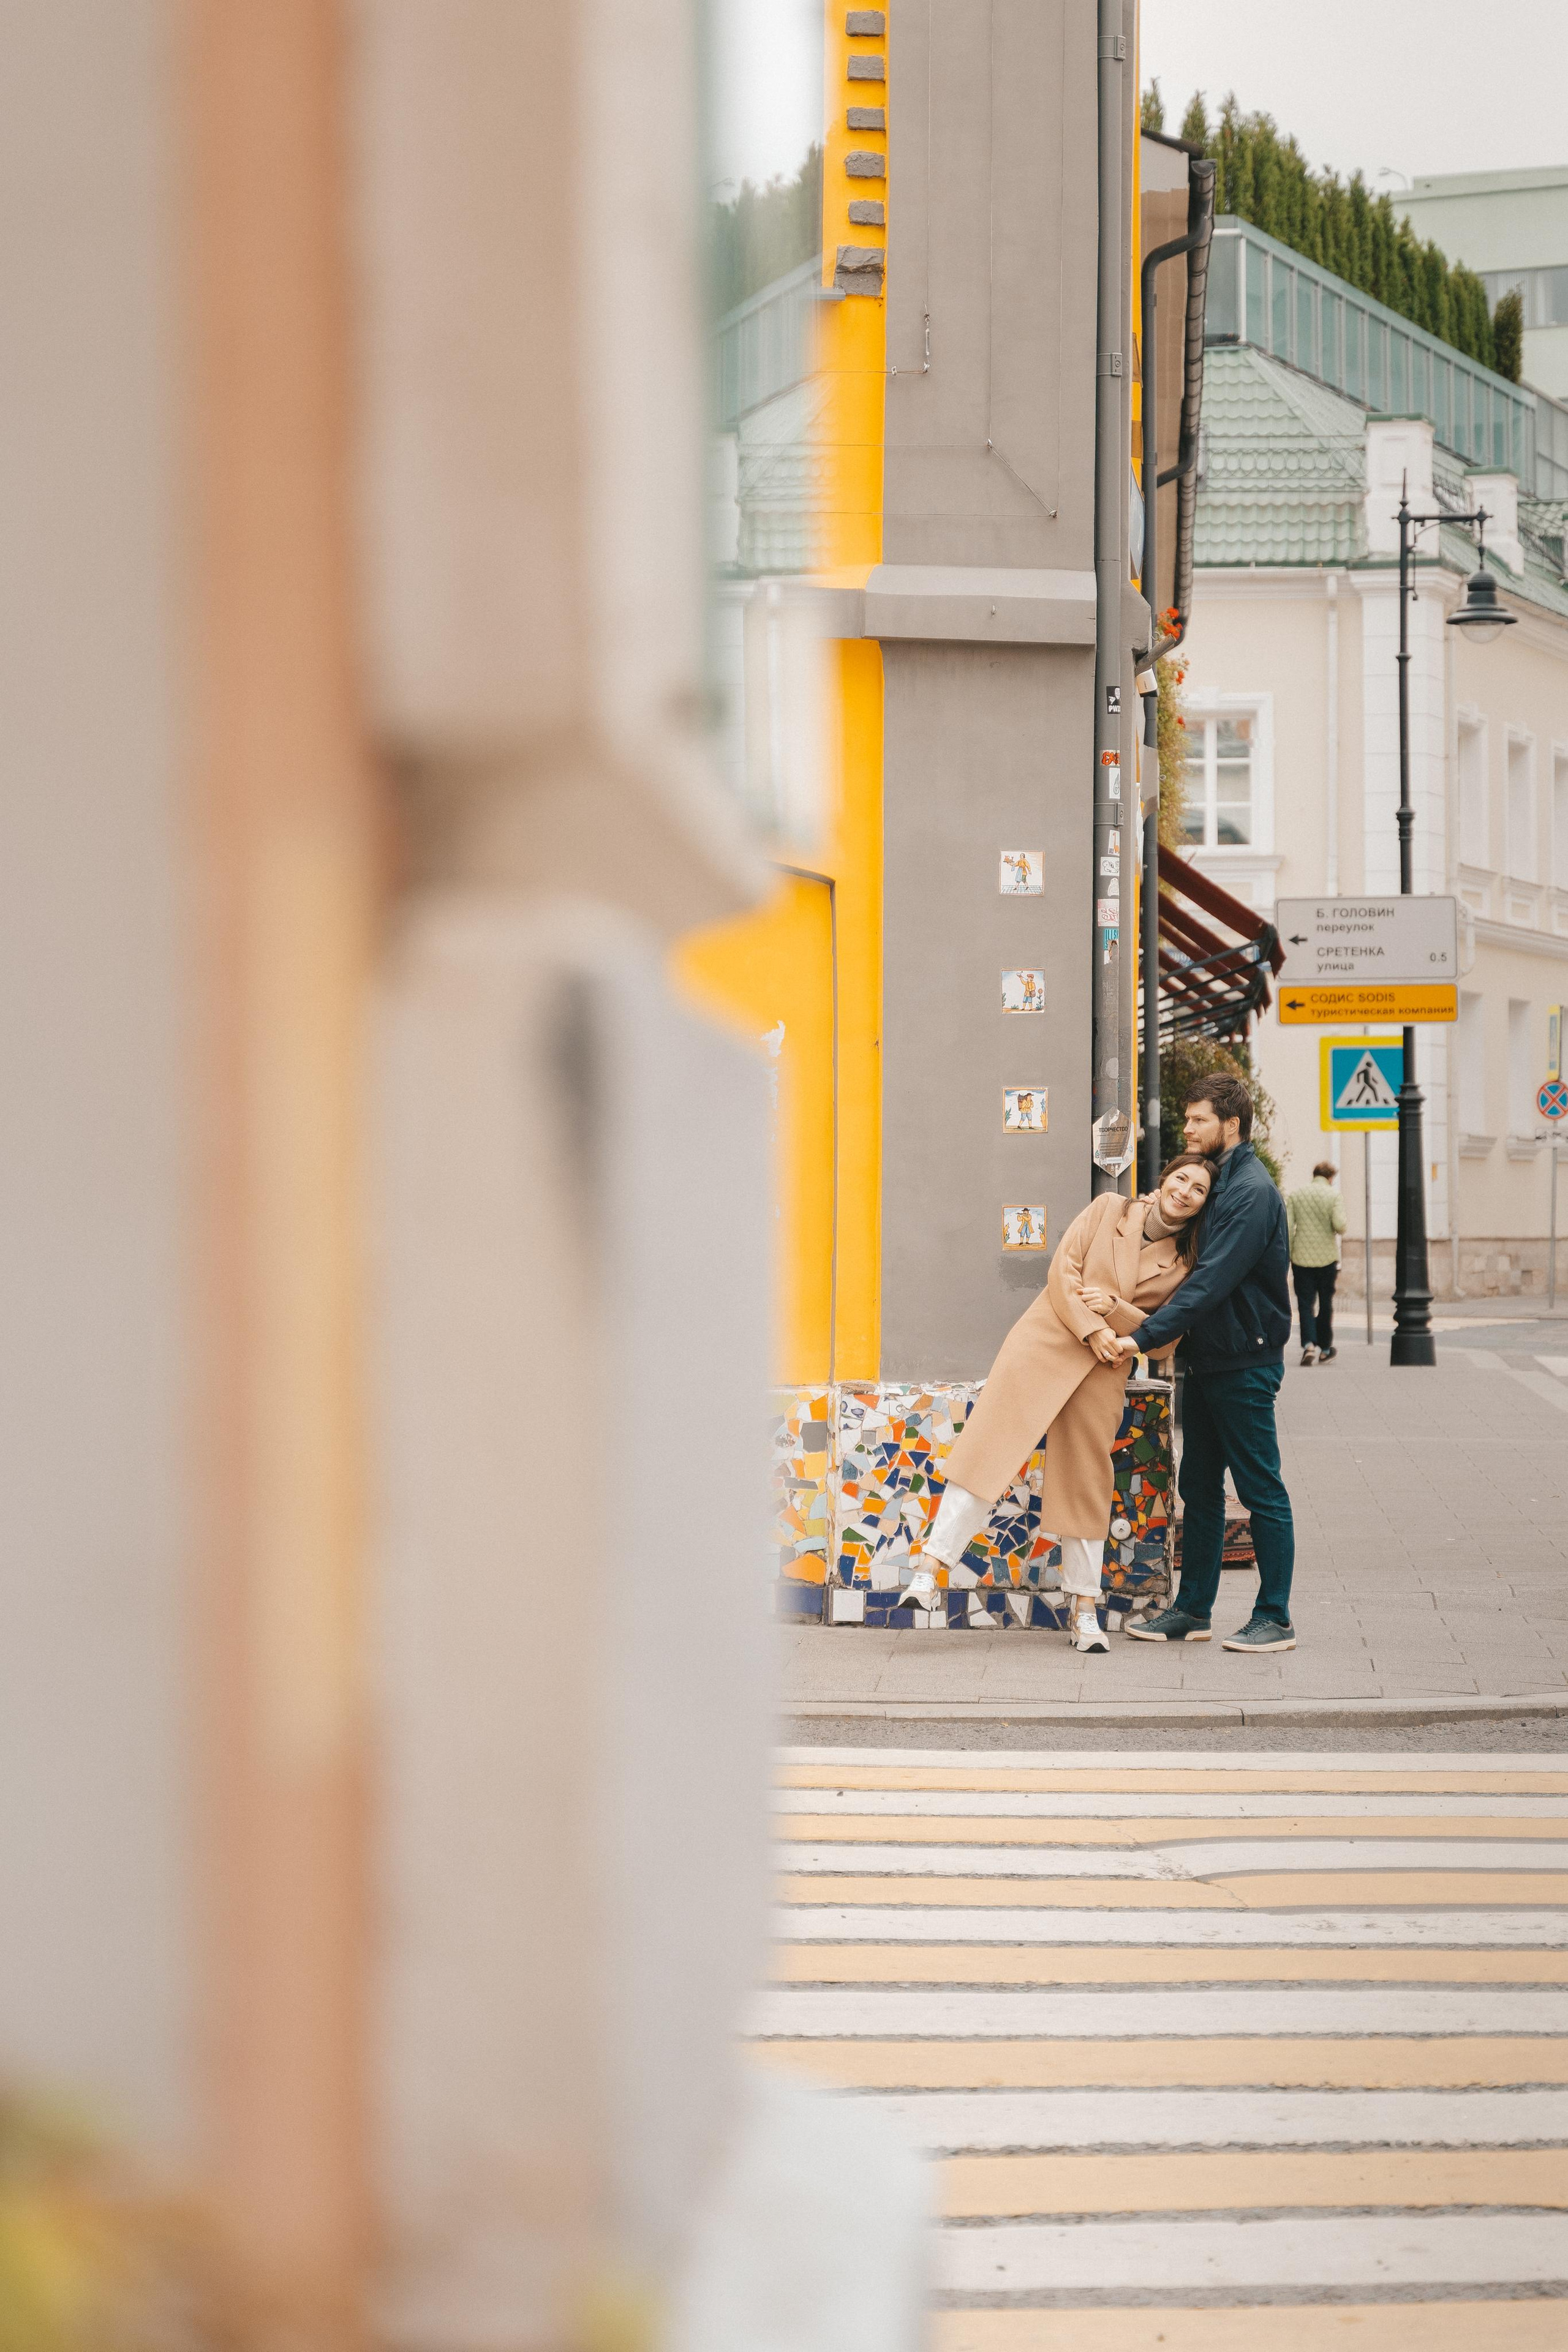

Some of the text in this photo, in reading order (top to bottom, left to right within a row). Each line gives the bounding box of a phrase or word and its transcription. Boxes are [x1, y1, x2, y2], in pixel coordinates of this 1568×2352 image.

[1317, 907, 1395, 919] Б. ГОЛОВИН
[1317, 924, 1374, 933] переулок
[1317, 946, 1385, 957] СРЕТЕНКА
[1430, 952, 1447, 962] 0.5
[1317, 962, 1355, 972] улица
[1311, 992, 1396, 1004] СОДИС SODIS
[1311, 1006, 1454, 1019] туристическая компания
